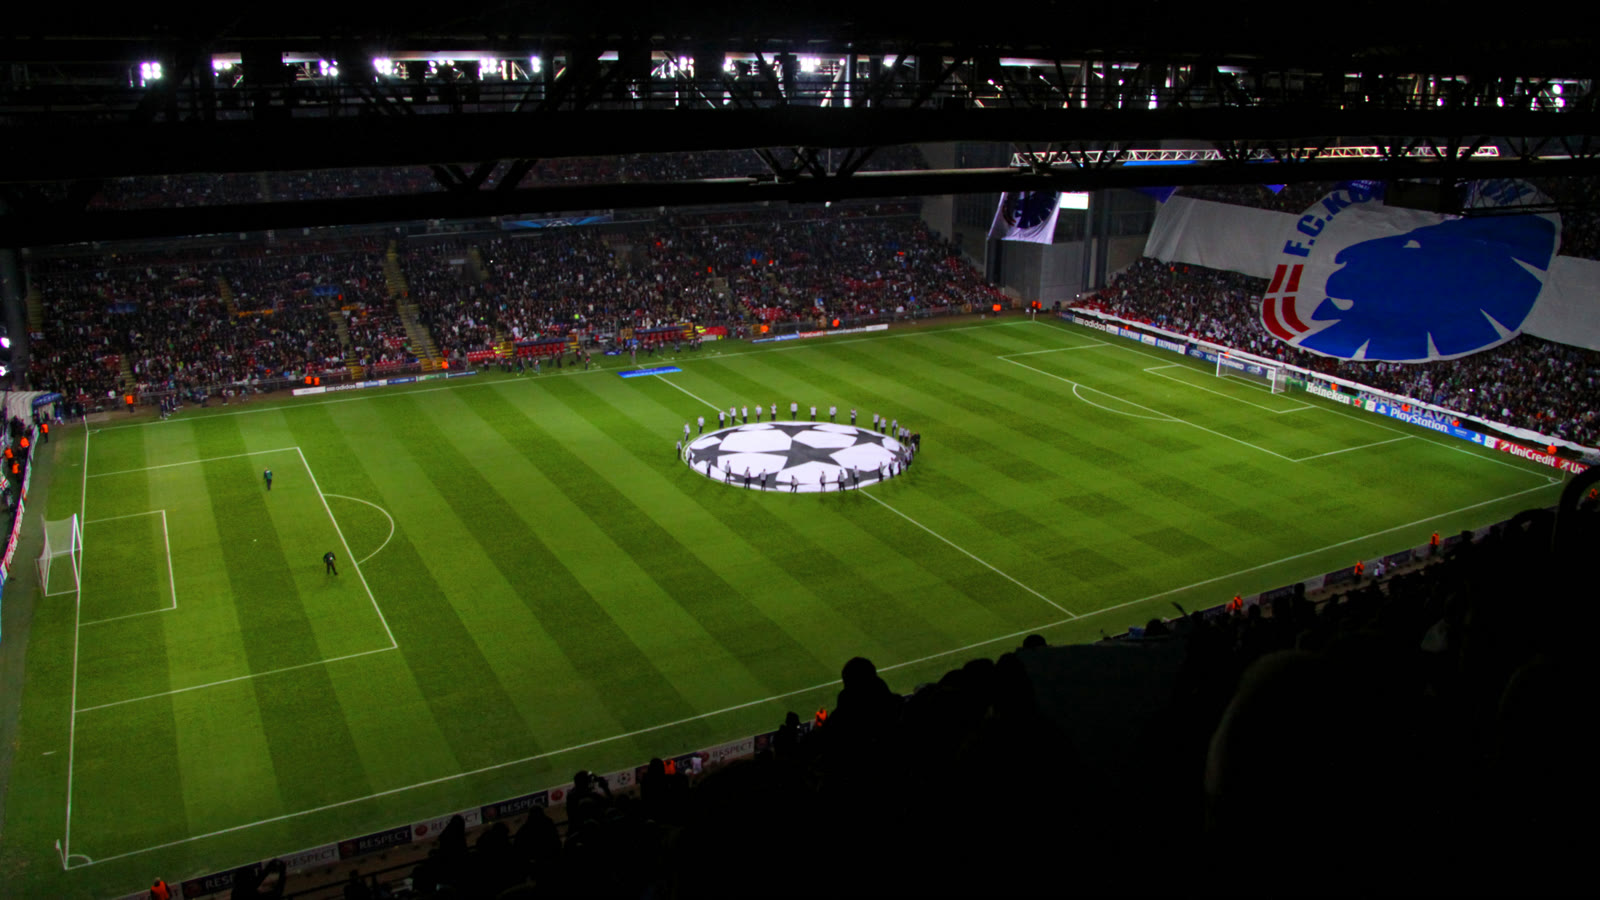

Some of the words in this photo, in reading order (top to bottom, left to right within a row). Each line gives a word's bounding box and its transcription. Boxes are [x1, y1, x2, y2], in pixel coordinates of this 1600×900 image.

[1084, 319, 1106, 331] adidas
[1306, 381, 1350, 404] Heineken
[1390, 408, 1449, 433] PlayStation
[1510, 444, 1556, 467] UniCredit
[710, 741, 753, 758] RESPECT
[499, 795, 546, 814] RESPECT
[359, 830, 409, 849] RESPECT
[286, 848, 336, 867] RESPECT
